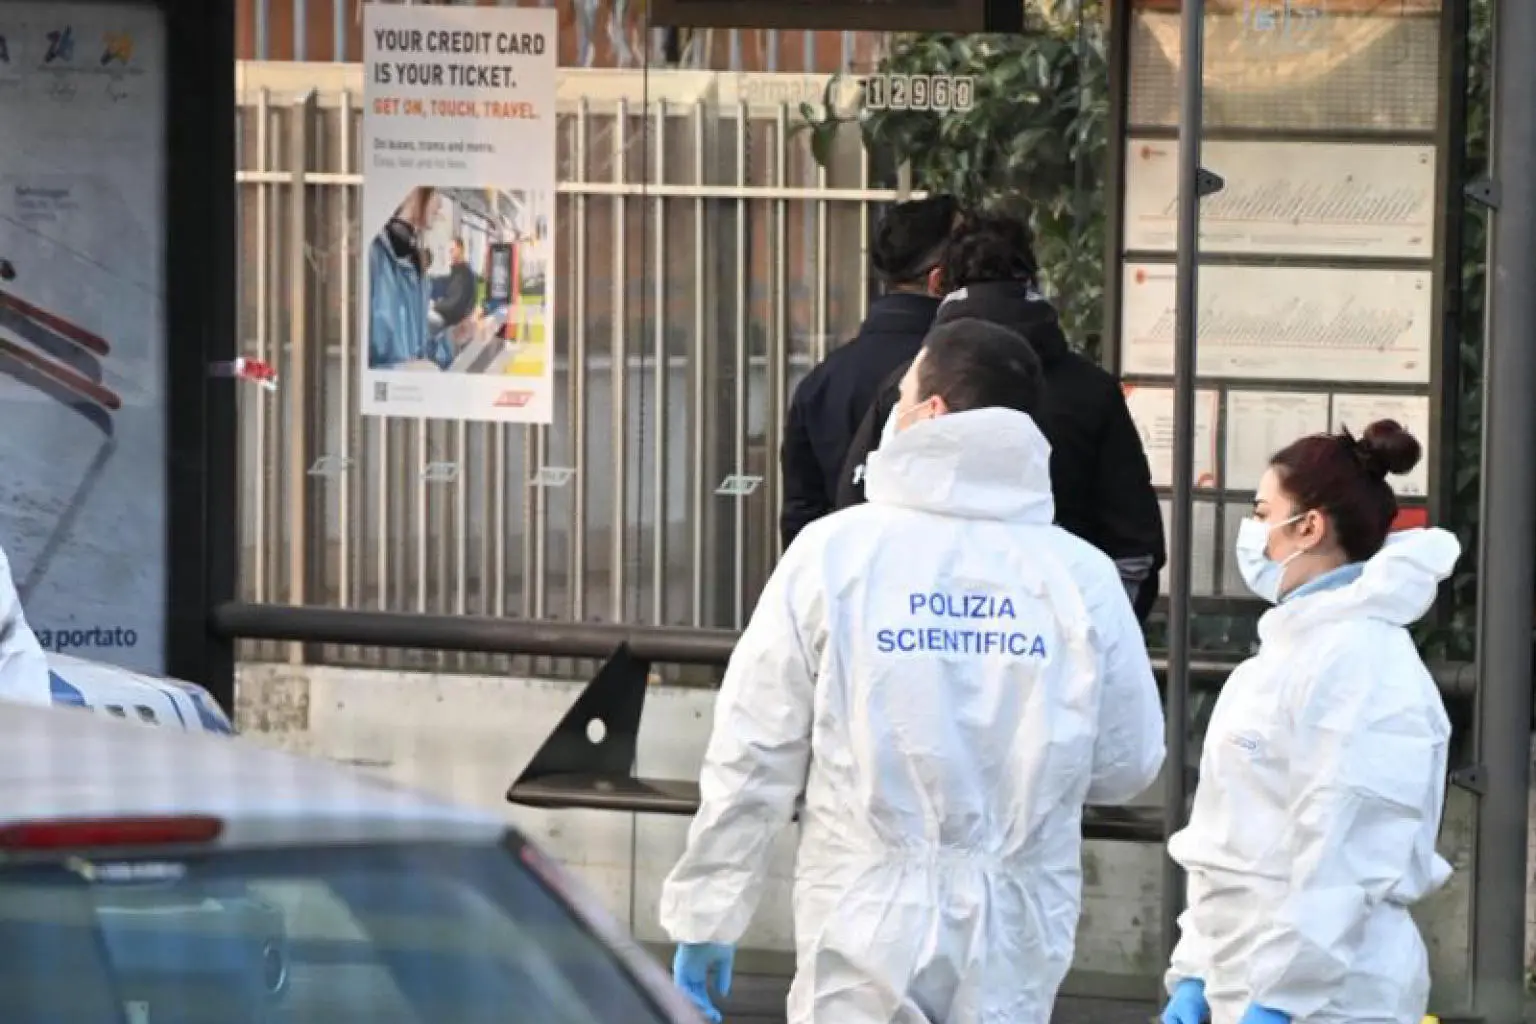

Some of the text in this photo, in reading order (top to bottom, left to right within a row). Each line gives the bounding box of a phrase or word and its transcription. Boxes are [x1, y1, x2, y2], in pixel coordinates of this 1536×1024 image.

[374, 29, 545, 55] YOUR CREDIT CARD
[374, 62, 517, 88] IS YOUR TICKET.
[869, 75, 972, 110] 12960
[373, 98, 400, 115] GET
[430, 100, 479, 118] TOUCH,
[484, 102, 541, 120] TRAVEL.
[909, 593, 1016, 620] POLIZIA
[56, 626, 138, 651] portato
[877, 628, 1047, 658] SCIENTIFICA
